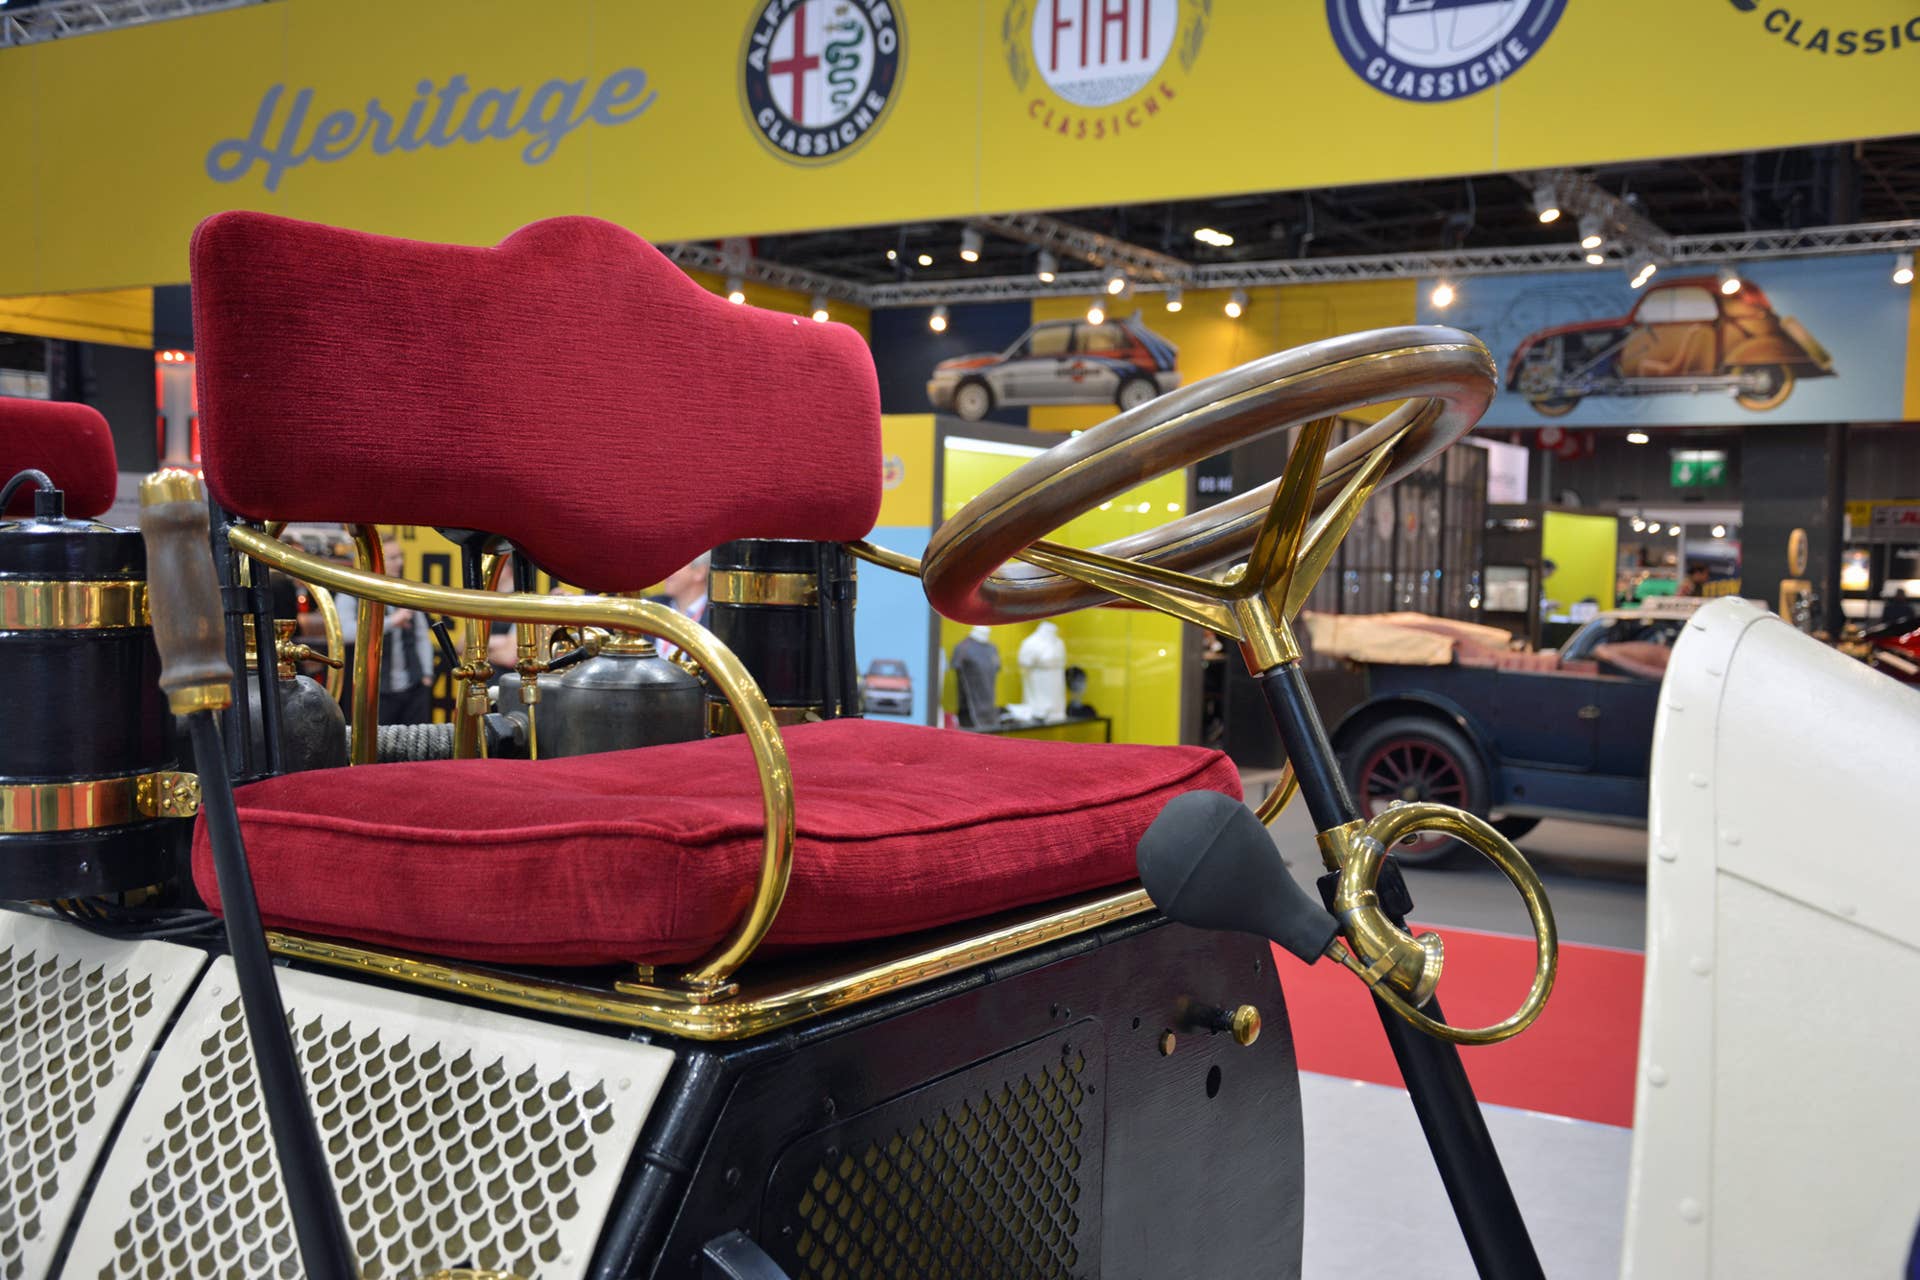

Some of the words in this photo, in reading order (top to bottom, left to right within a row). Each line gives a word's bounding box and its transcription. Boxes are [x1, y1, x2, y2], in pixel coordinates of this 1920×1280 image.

[749, 0, 794, 72] ALF
[1366, 36, 1529, 98] CLASSICHE
[205, 67, 659, 193] Heritage
[757, 90, 886, 156] CLASSICHE
[1028, 81, 1176, 140] CLASSICHE
